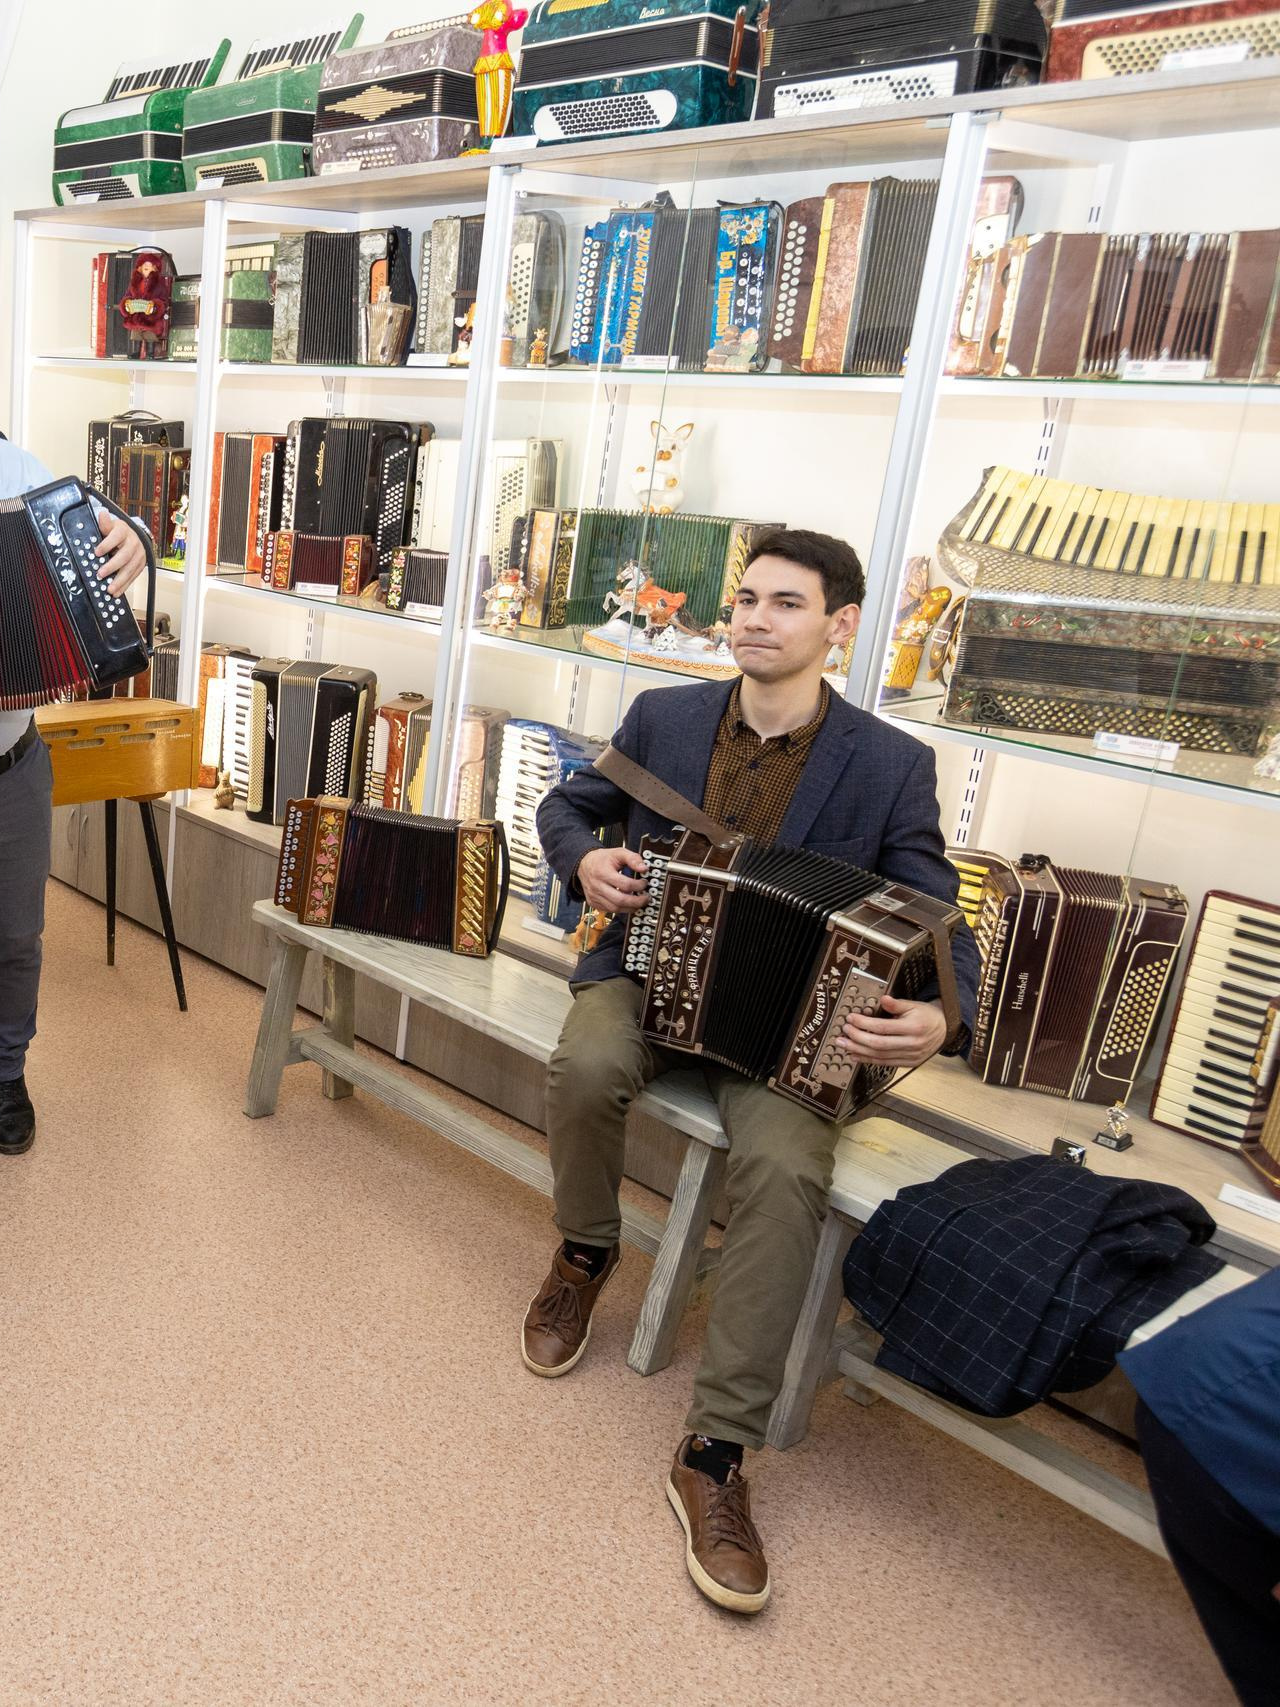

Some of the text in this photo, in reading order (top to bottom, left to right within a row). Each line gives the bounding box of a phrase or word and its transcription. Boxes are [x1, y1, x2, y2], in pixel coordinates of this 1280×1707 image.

[719, 251, 736, 274] Бр.
[623, 227, 651, 355] ТУЛЬСКАЯ ГАРМОНЬ
[687, 945, 704, 990] ФРАНЦЕВ
[812, 991, 826, 1026] КОЗЛОВ
[1011, 972, 1029, 1010] Hutschelli
